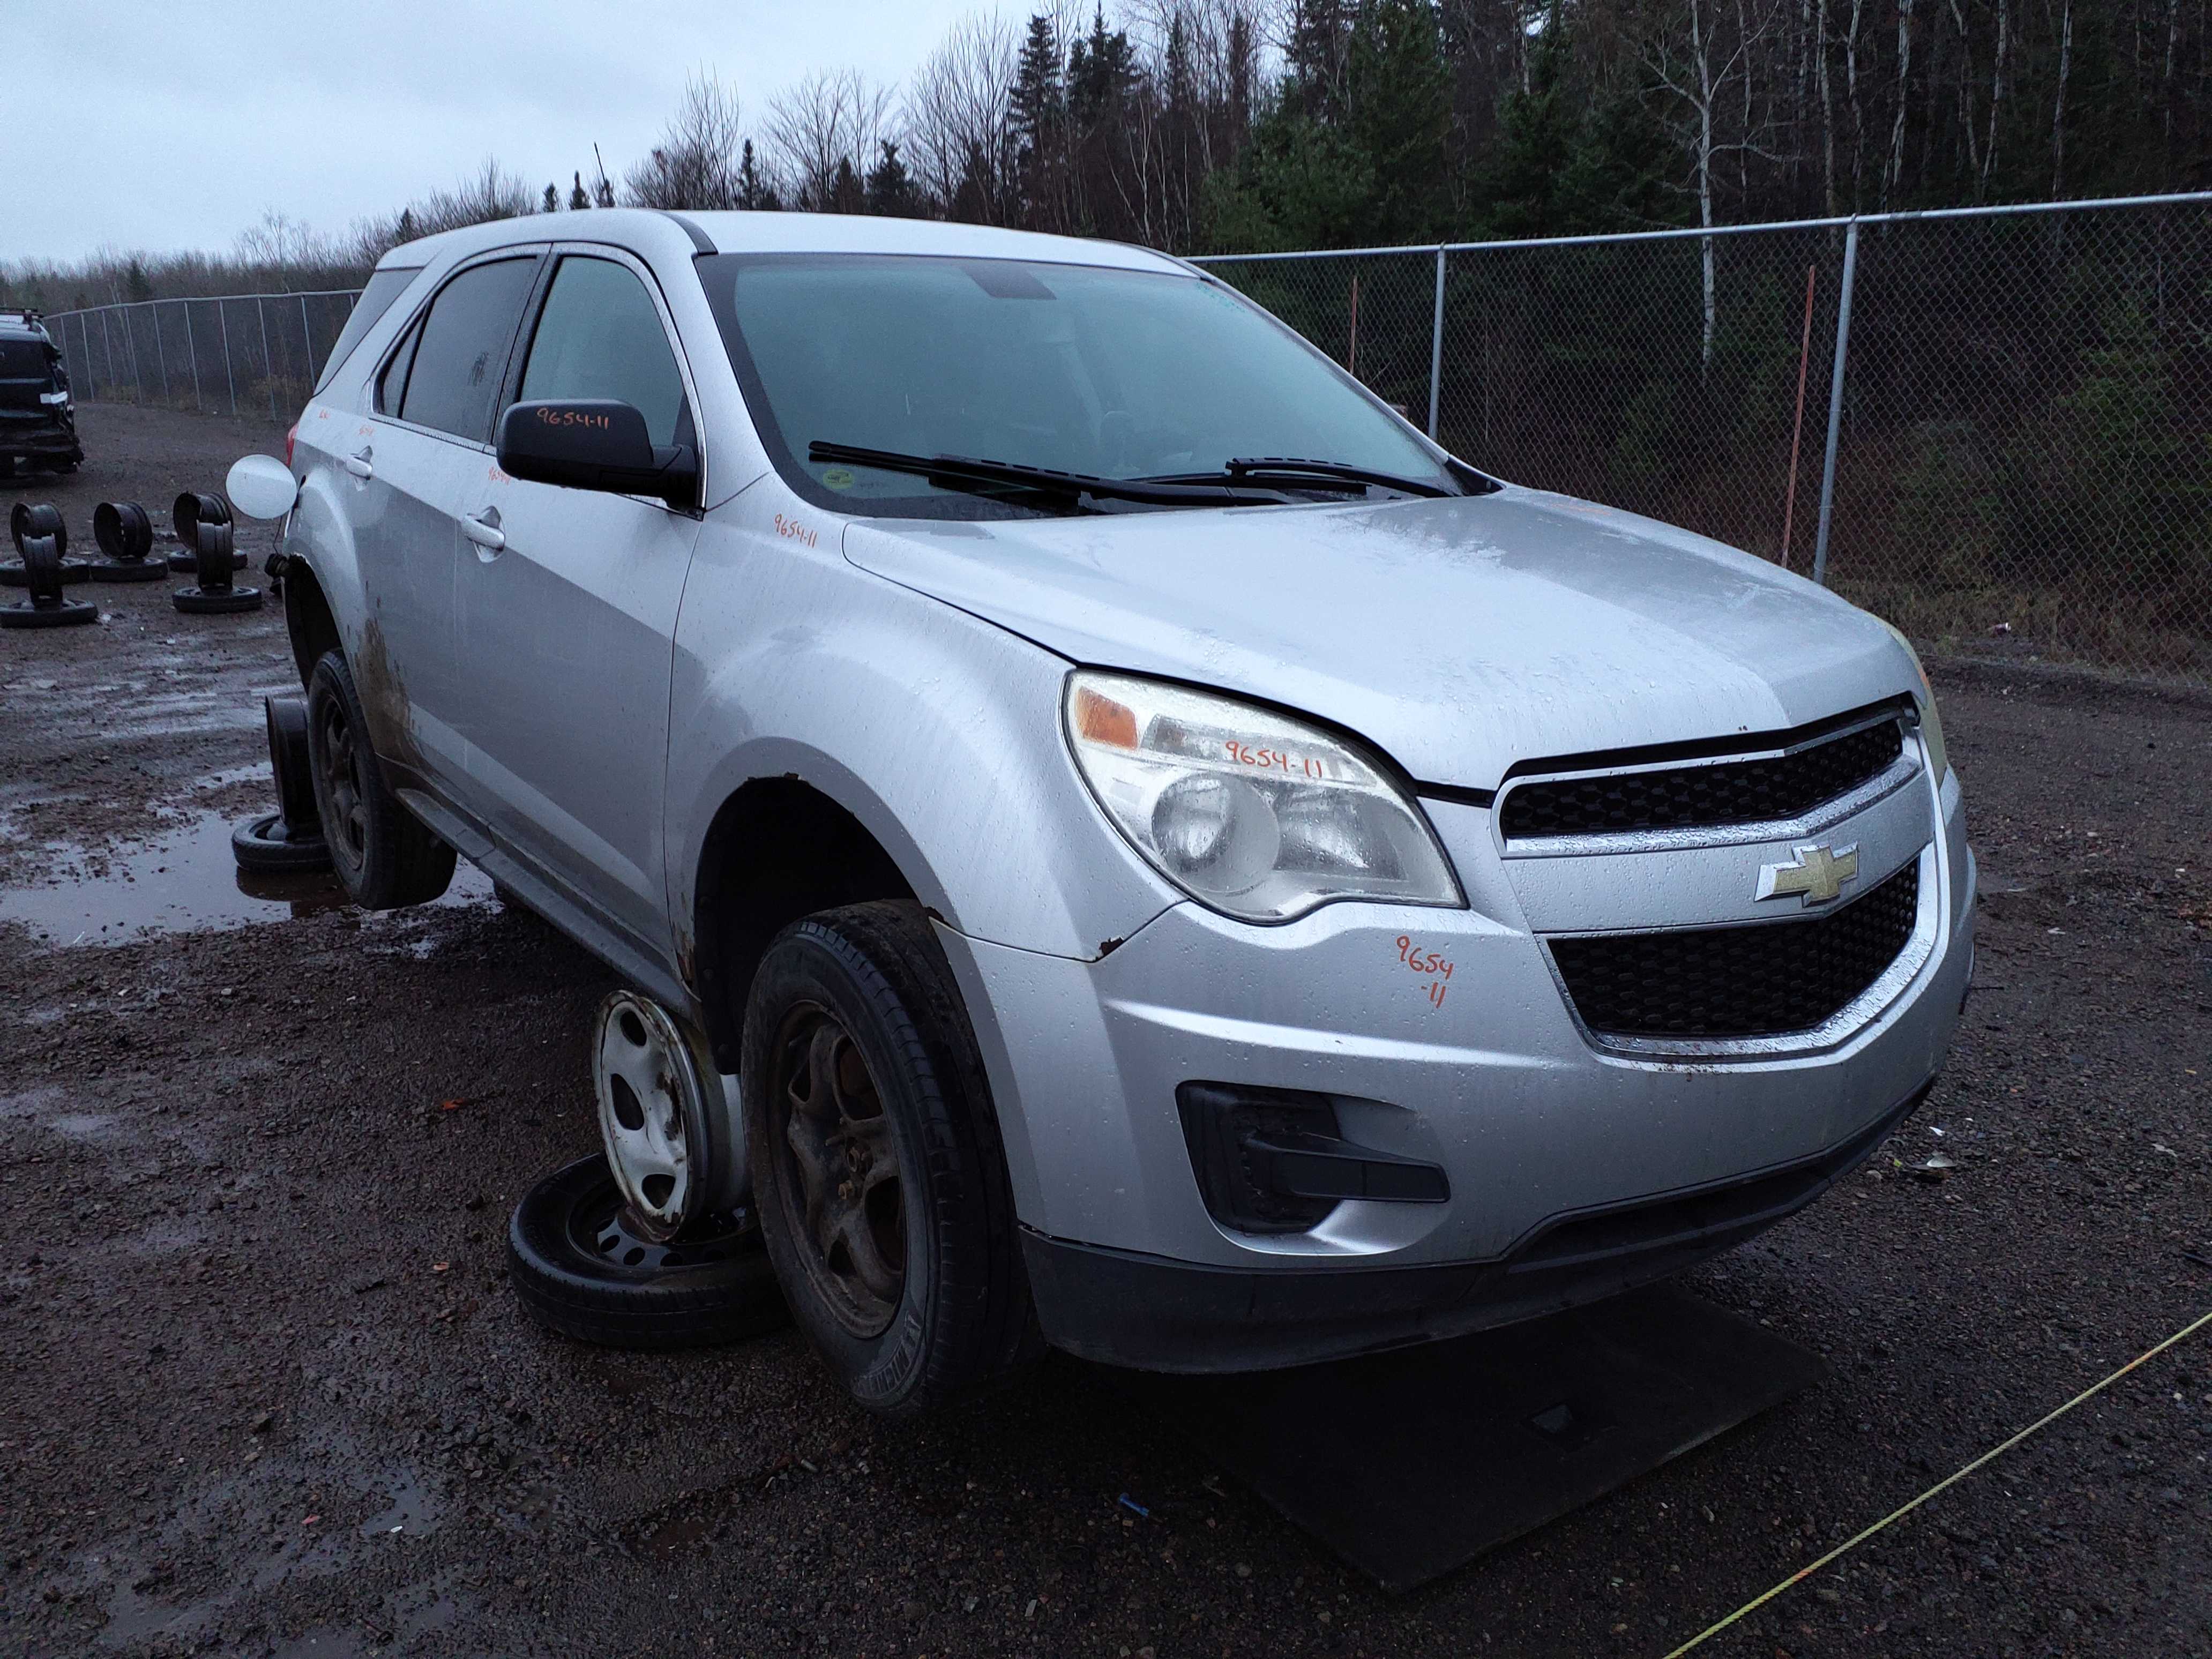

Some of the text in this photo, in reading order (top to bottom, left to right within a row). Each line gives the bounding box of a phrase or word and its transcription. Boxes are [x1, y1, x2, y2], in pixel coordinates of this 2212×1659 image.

[537, 408, 609, 429] 9654-11
[774, 513, 817, 548] 9654-11
[1225, 741, 1322, 778] 9654-11
[1396, 935, 1454, 980] 9654
